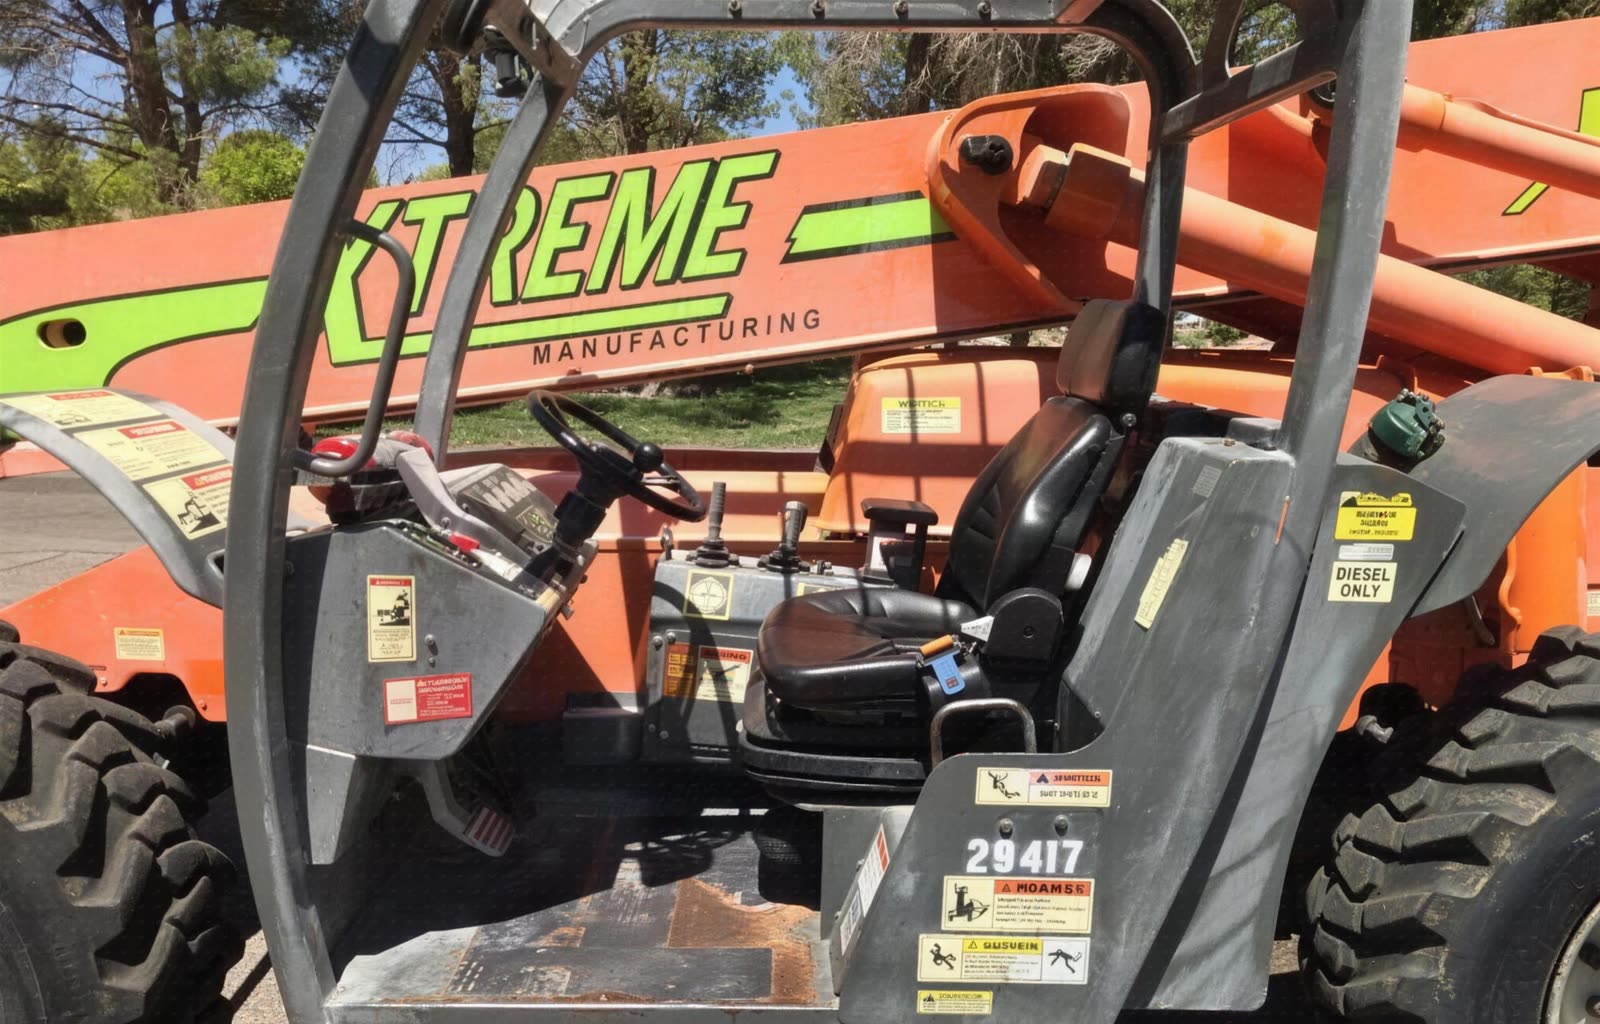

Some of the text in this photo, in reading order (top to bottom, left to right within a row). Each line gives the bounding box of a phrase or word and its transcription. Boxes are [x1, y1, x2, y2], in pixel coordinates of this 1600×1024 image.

[532, 309, 821, 366] MANUFACTURING
[1336, 567, 1390, 582] DIESEL
[1340, 583, 1381, 598] ONLY
[966, 838, 1084, 874] 29417
